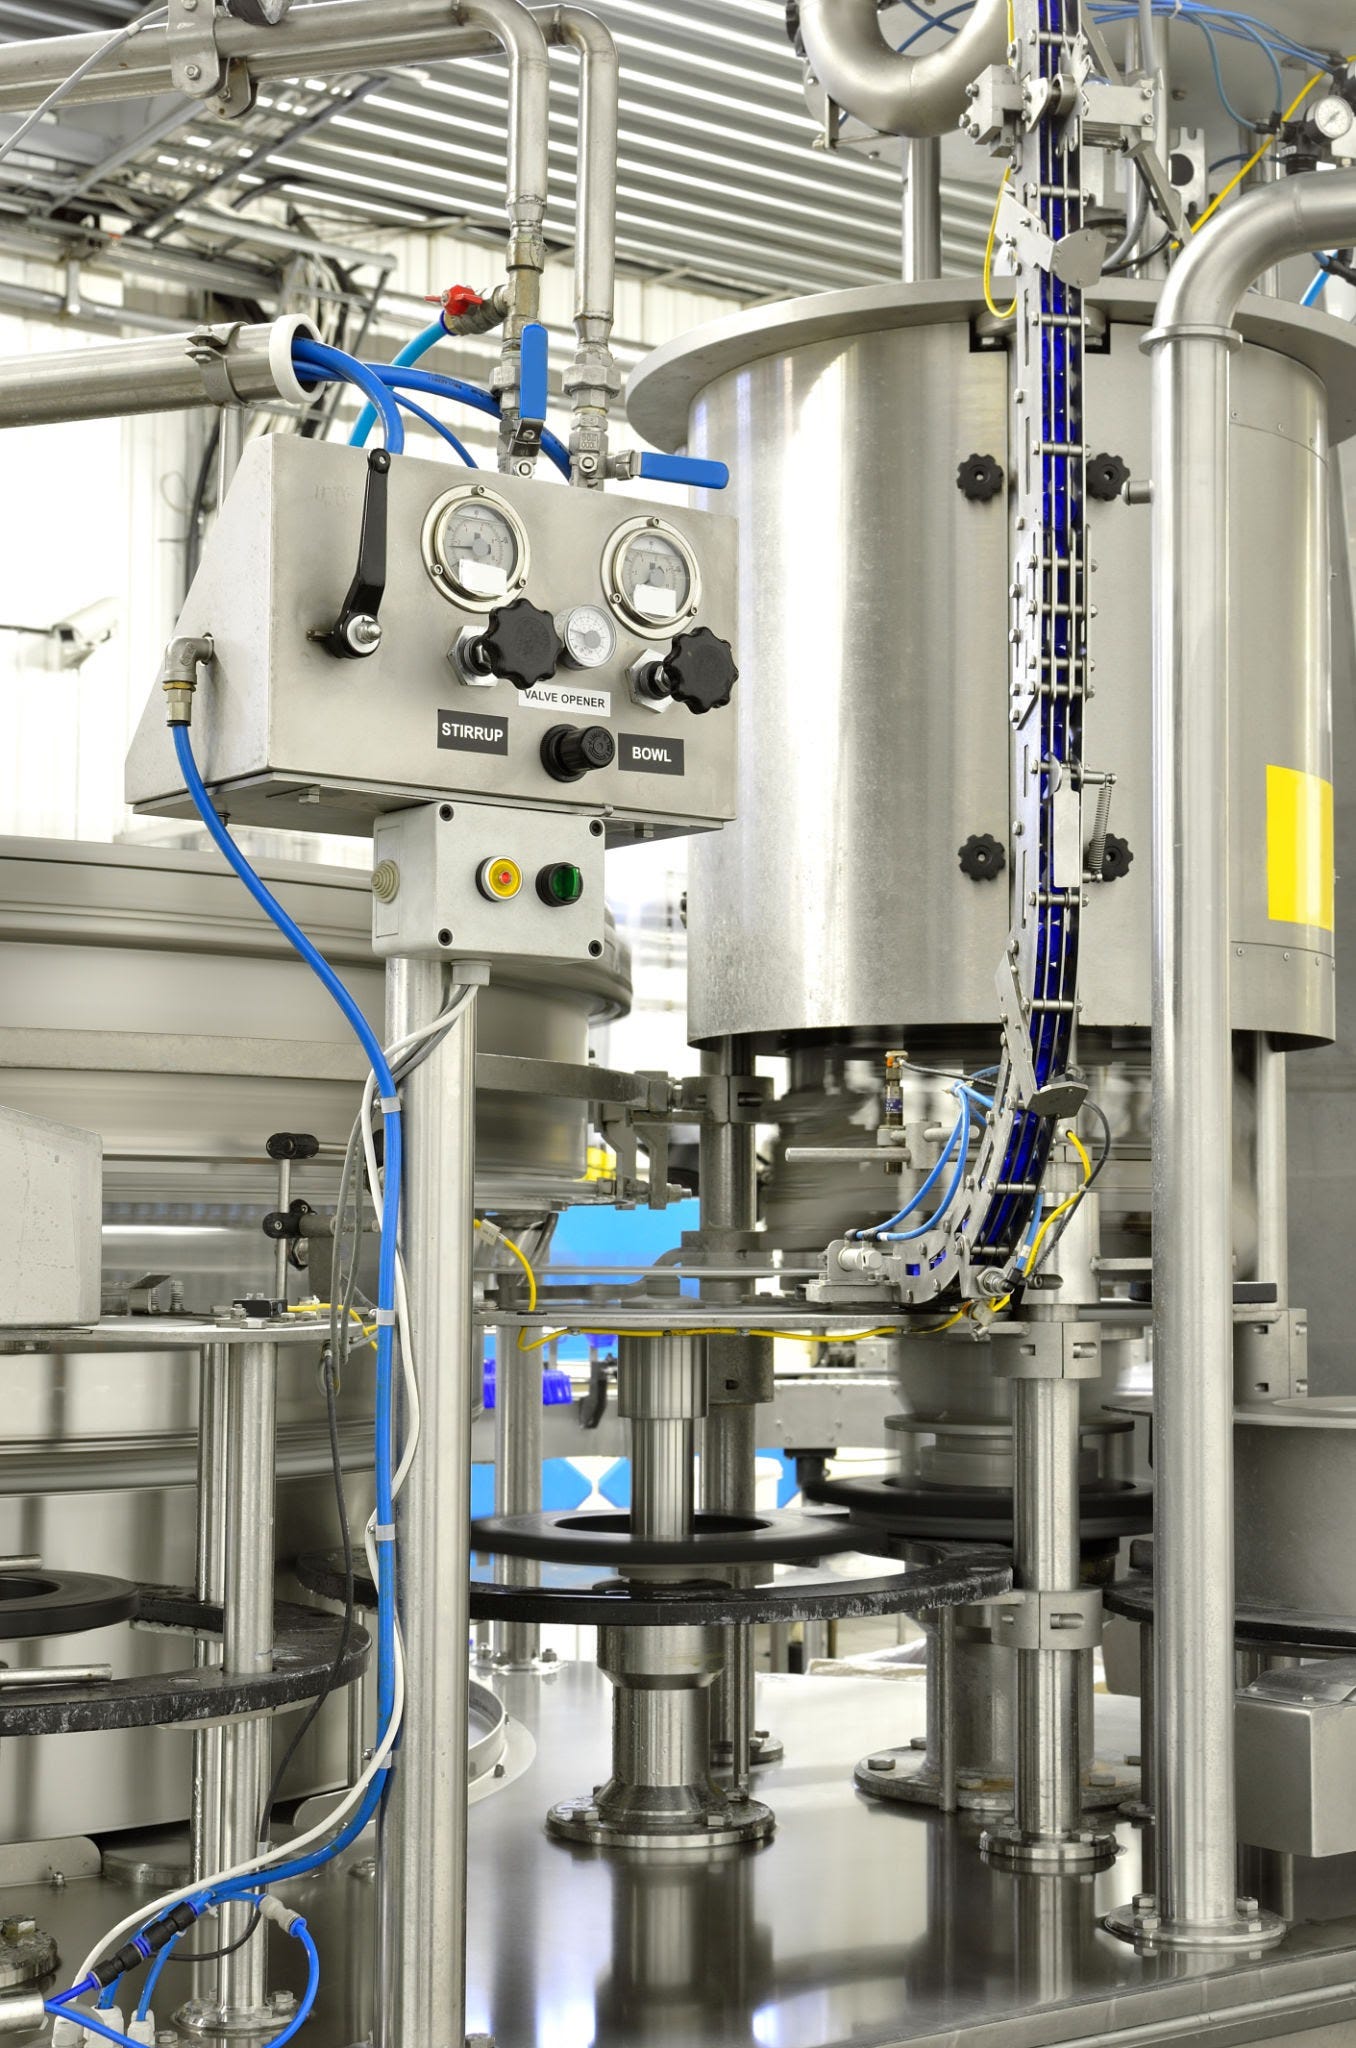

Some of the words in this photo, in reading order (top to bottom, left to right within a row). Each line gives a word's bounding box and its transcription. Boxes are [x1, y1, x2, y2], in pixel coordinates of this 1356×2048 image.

[524, 689, 558, 703] VALVE
[561, 694, 605, 708] OPENER
[441, 722, 504, 742] STIRRUP
[632, 746, 672, 763] BOWL
